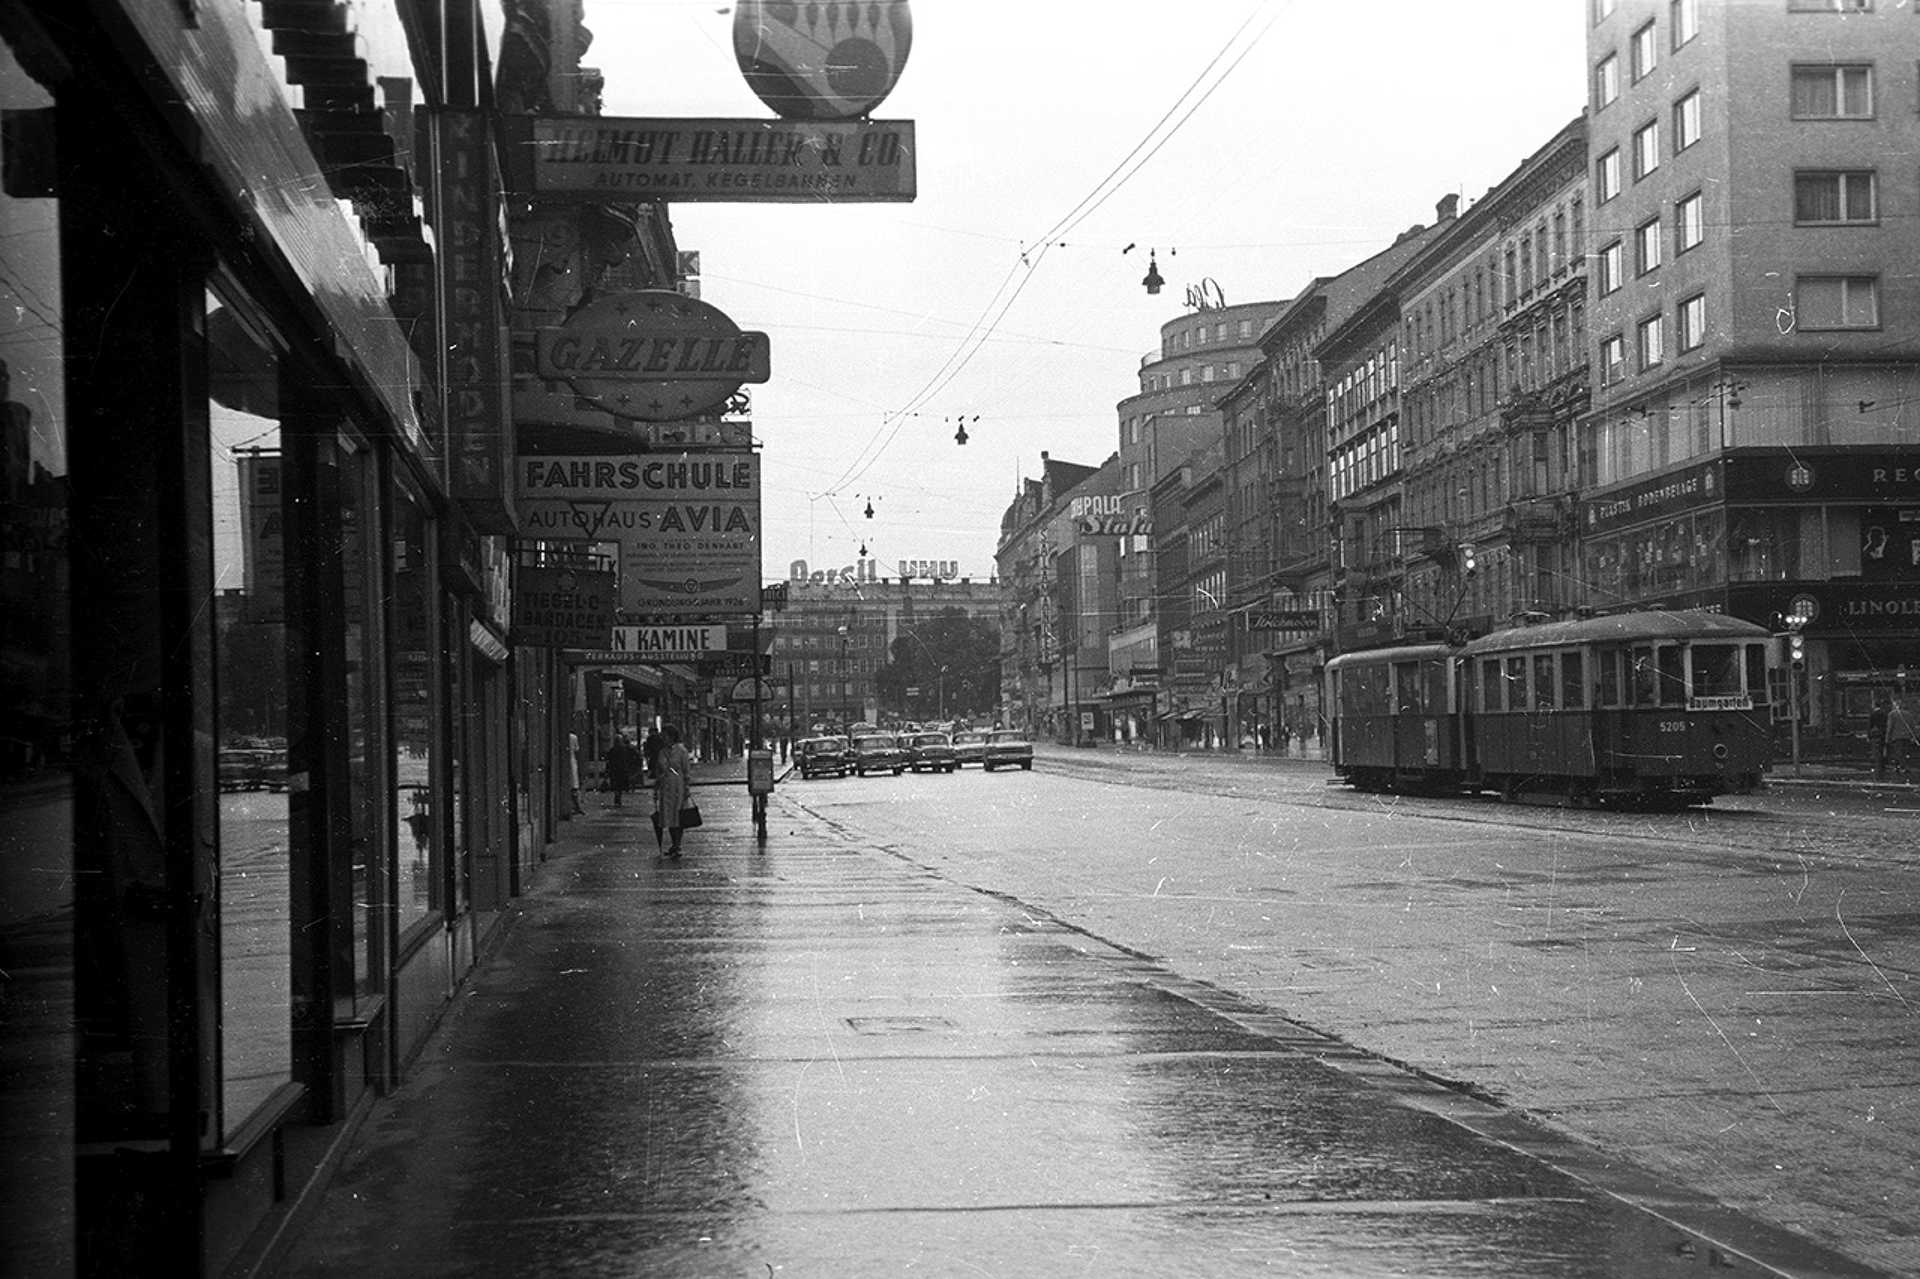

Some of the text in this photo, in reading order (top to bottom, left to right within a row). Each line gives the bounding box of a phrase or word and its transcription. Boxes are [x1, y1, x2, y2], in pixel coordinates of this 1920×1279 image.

[552, 338, 759, 371] GAZELLE
[527, 461, 750, 489] FAHRSCHULE
[528, 506, 750, 532] AUTOHAUS AVIA
[898, 560, 958, 580] UHU
[638, 629, 710, 650] KAMINE
[1690, 697, 1749, 710] Baumgarten
[1659, 721, 1686, 732] 5205
